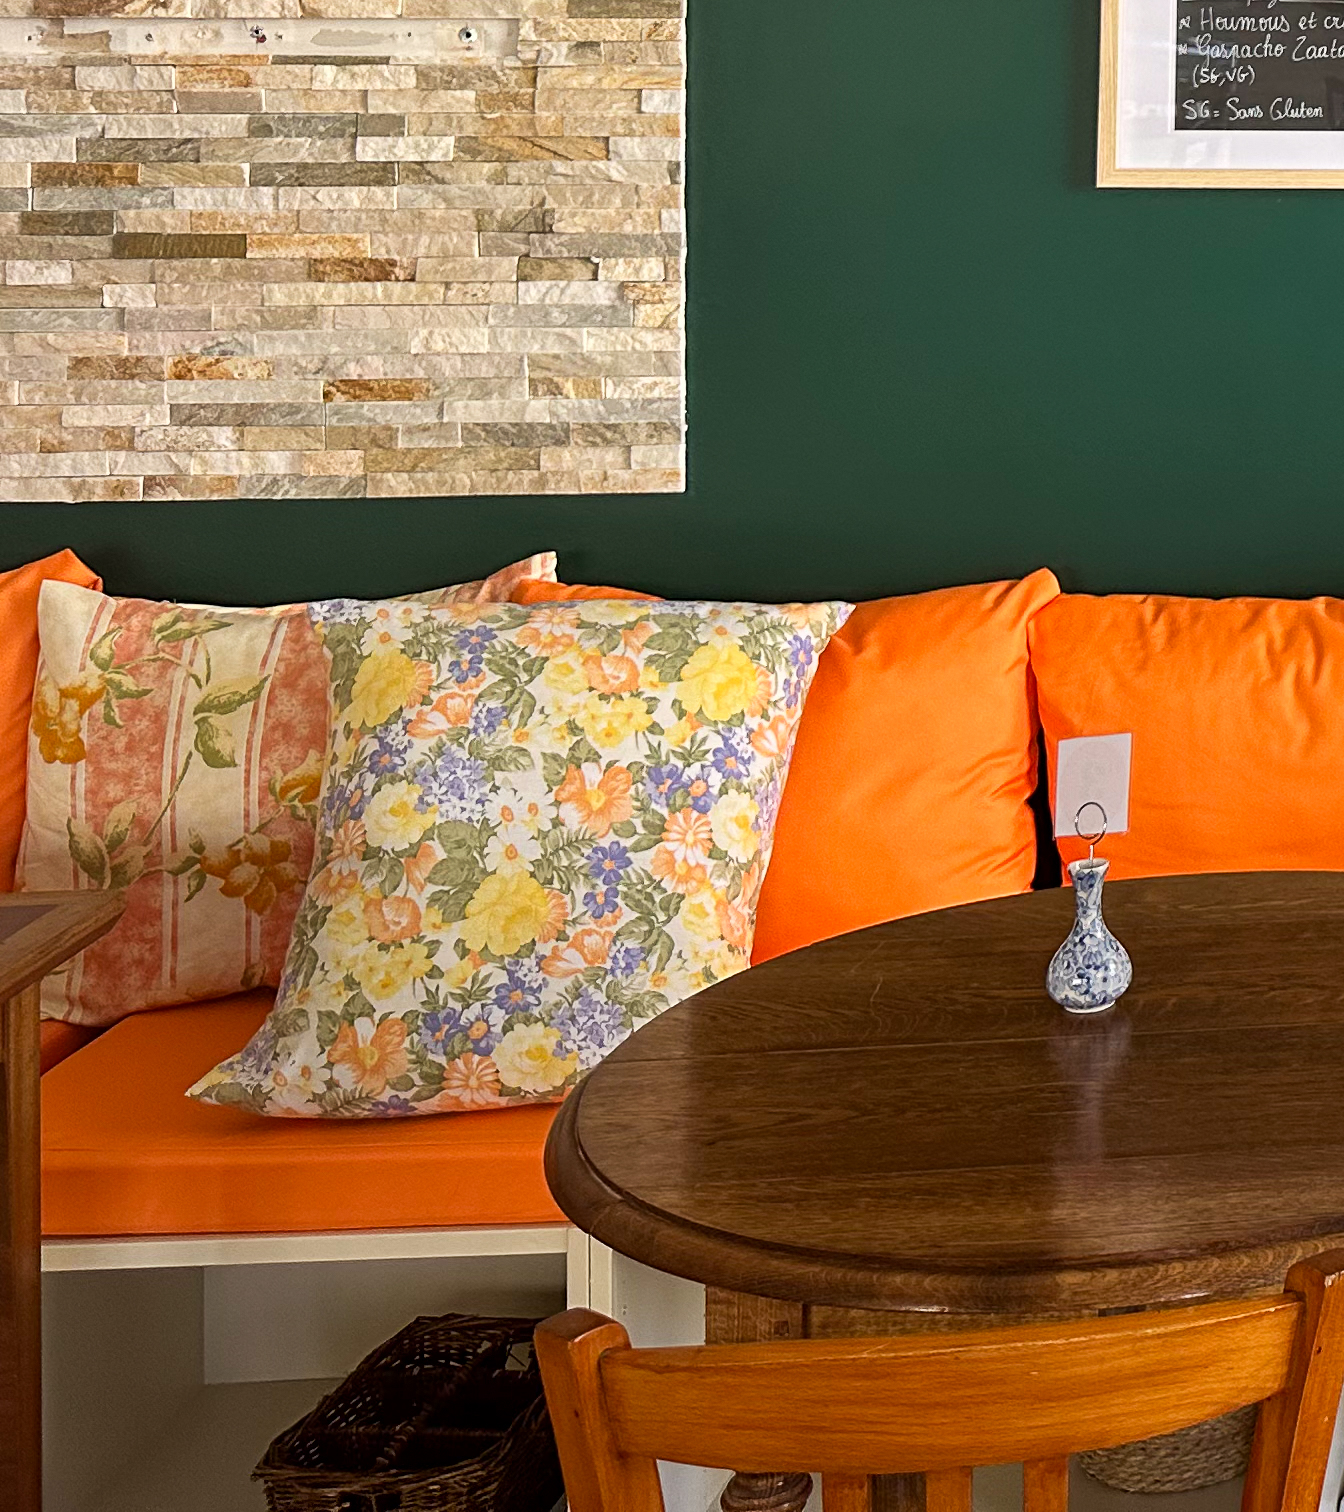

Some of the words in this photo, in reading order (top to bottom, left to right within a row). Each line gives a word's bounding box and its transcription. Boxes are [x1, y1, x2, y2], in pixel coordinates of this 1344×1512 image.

[1200, 7, 1291, 32] Houmous
[1298, 11, 1318, 31] et
[1196, 33, 1287, 68] Gaspacho
[1225, 97, 1264, 121] Sans
[1269, 97, 1324, 121] Gluten
